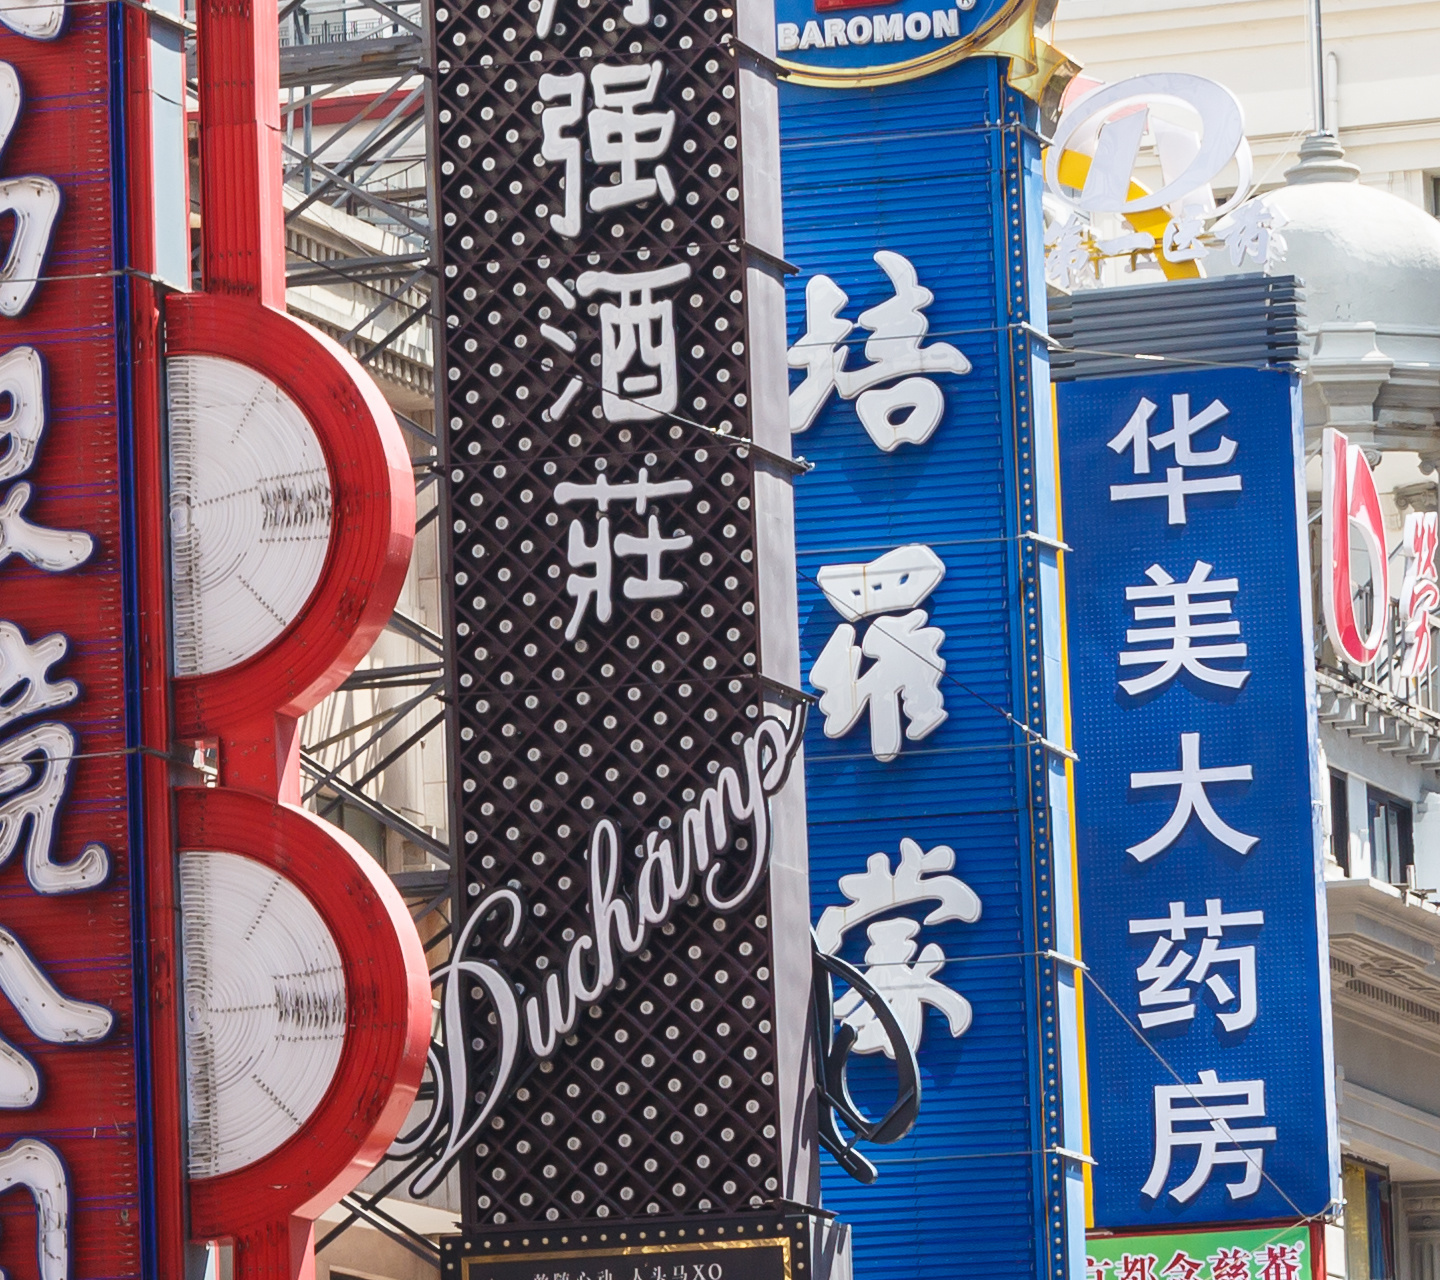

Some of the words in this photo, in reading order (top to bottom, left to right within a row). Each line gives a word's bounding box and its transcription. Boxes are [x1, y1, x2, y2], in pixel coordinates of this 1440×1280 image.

[776, 9, 959, 52] BAROMON
[1106, 392, 1277, 1204] 华美大药房
